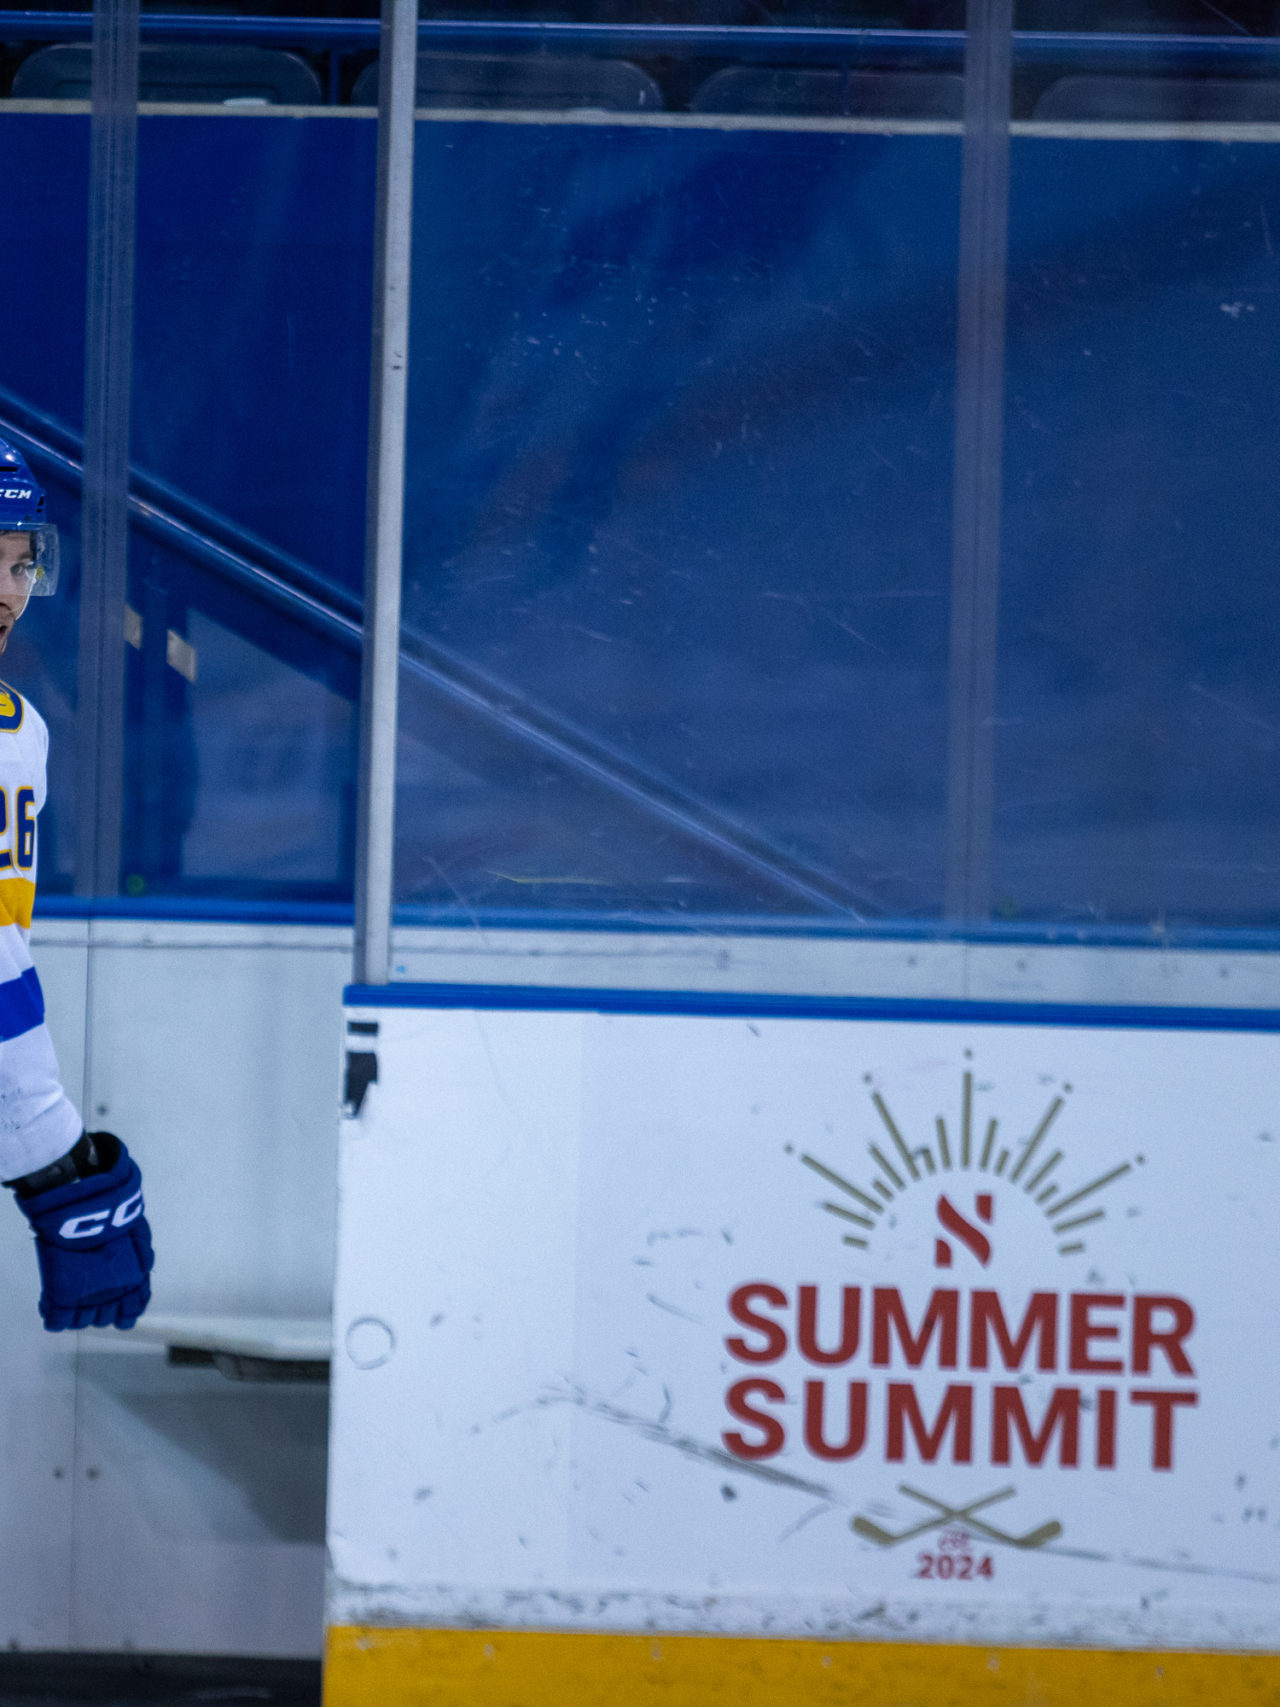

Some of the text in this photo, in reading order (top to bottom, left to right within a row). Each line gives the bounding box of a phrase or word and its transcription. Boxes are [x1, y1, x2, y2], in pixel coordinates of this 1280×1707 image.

[725, 1282, 1197, 1378] SUMMER
[721, 1377, 1199, 1472] SUMMIT
[917, 1554, 994, 1580] 2024
